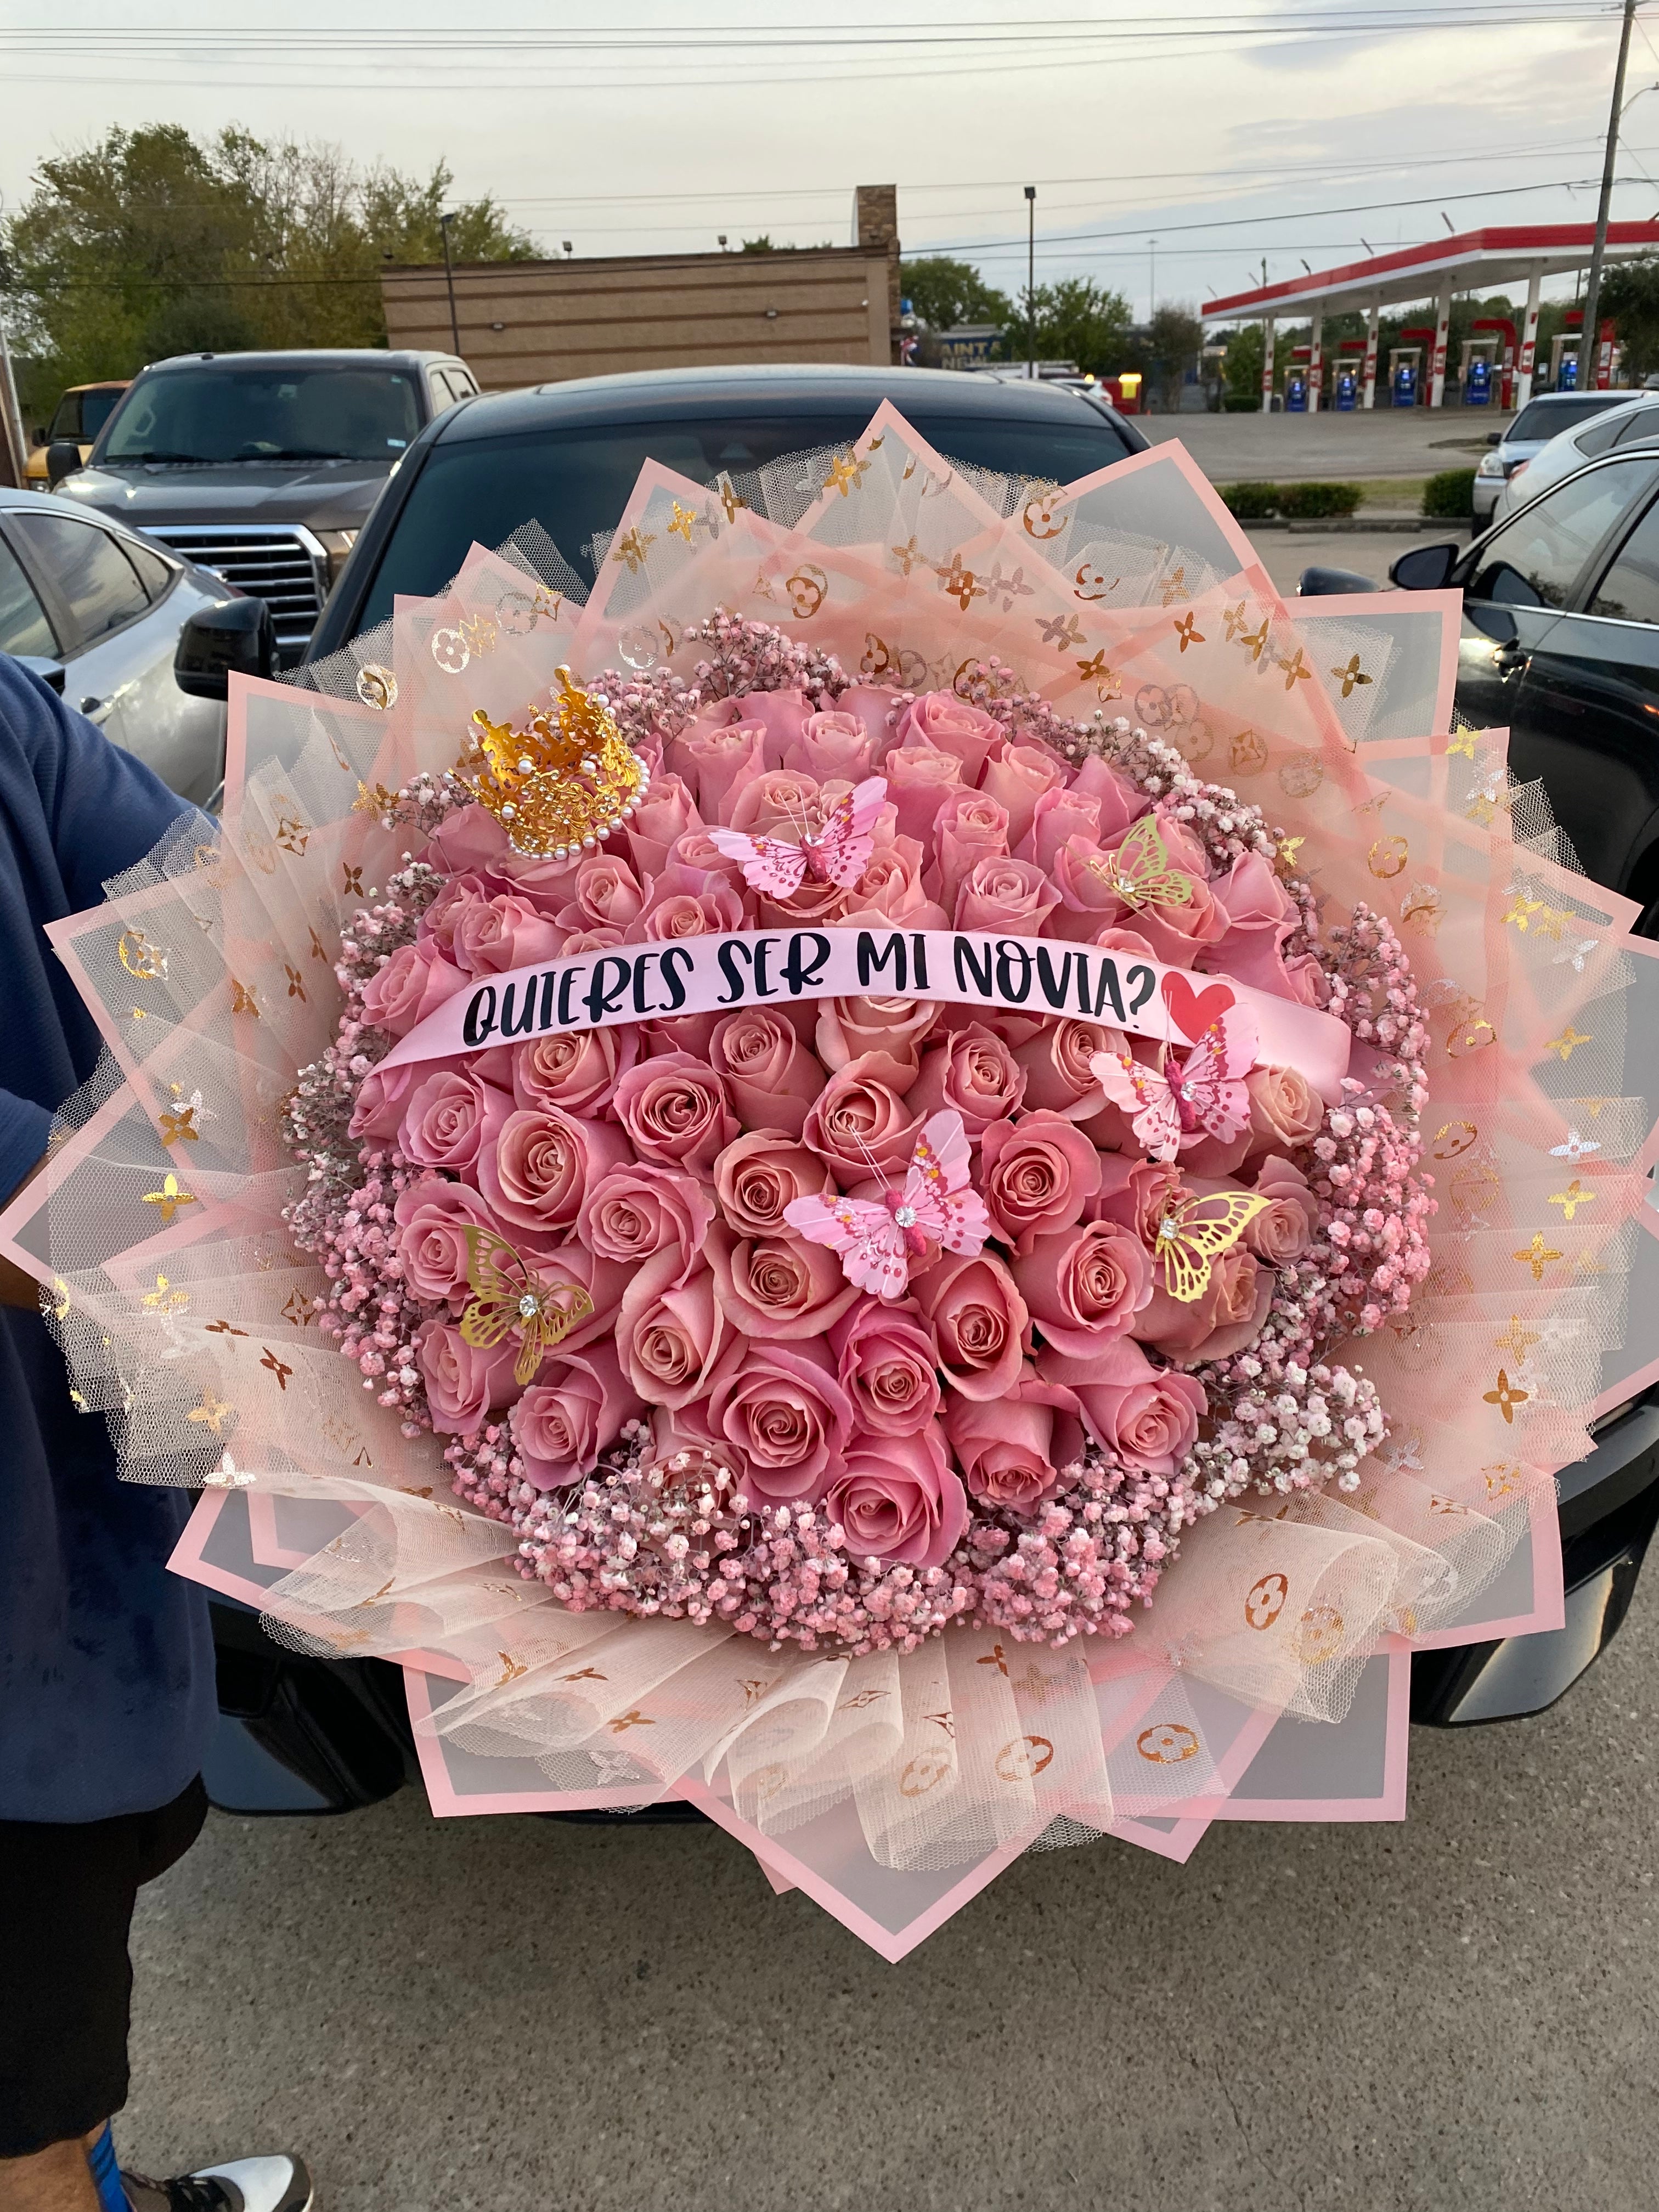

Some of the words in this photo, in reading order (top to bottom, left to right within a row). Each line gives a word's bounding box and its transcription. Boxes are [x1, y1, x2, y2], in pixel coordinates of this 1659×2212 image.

[463, 947, 694, 1047] QUIERES
[717, 932, 831, 1003] SER
[857, 932, 931, 991] MI
[953, 936, 1156, 1029] NOVIA?
